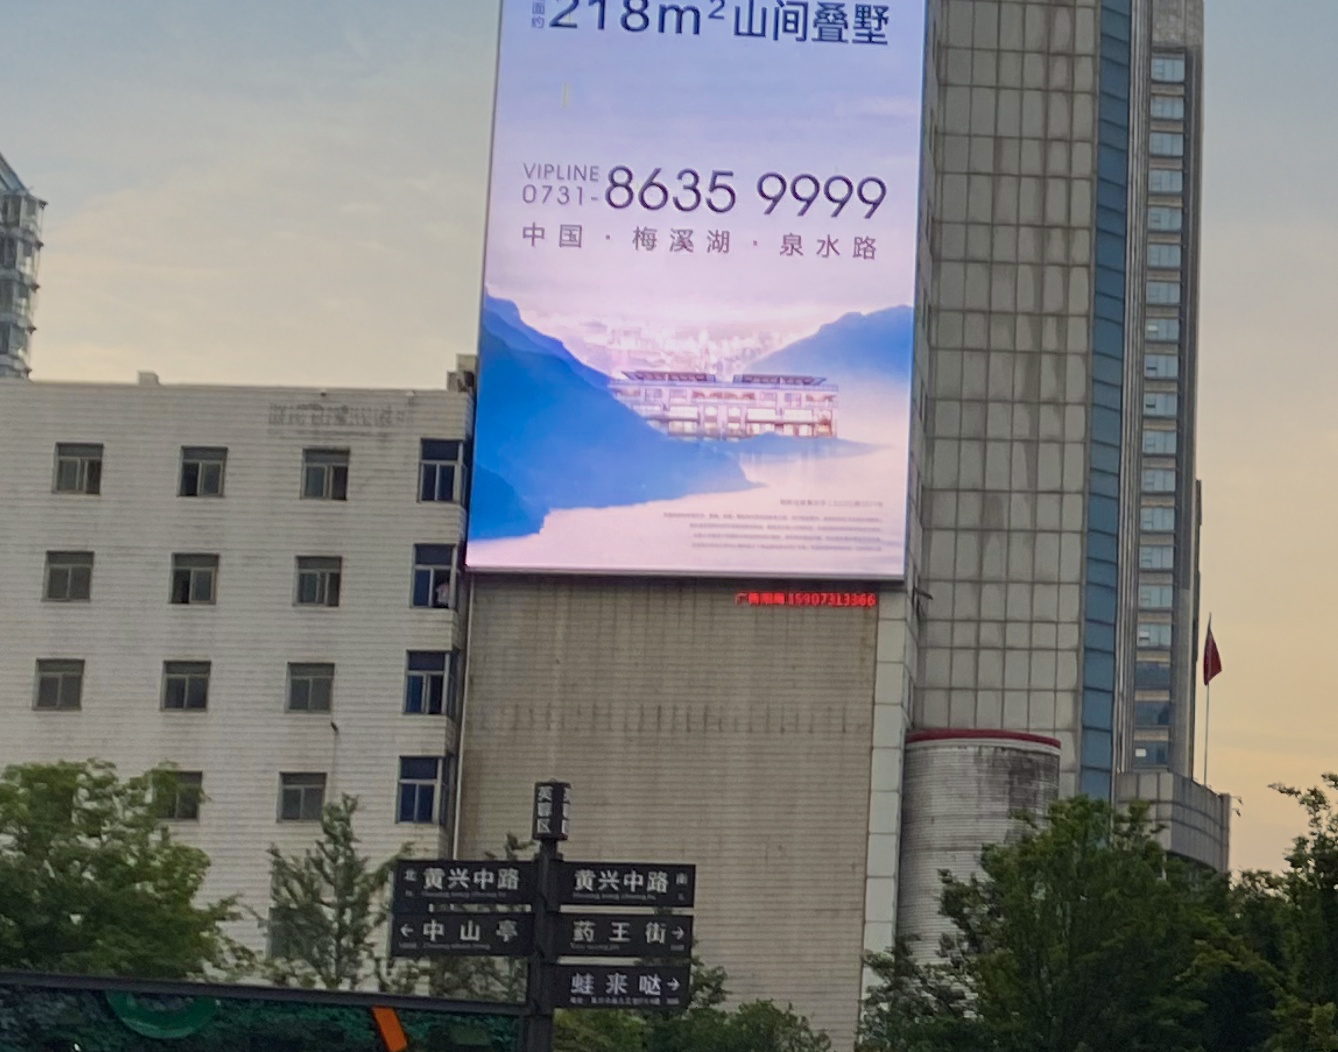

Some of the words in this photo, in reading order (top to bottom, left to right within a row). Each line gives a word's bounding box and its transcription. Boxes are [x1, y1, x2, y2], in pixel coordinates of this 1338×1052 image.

[522, 162, 600, 183] VIPLINE
[756, 172, 888, 221] 9999
[423, 867, 520, 890] 黄兴中路
[574, 868, 669, 893] 黄兴中路
[423, 919, 519, 942] 中山亭
[572, 920, 667, 944] 药王街
[570, 972, 662, 996] 蛙来哒
